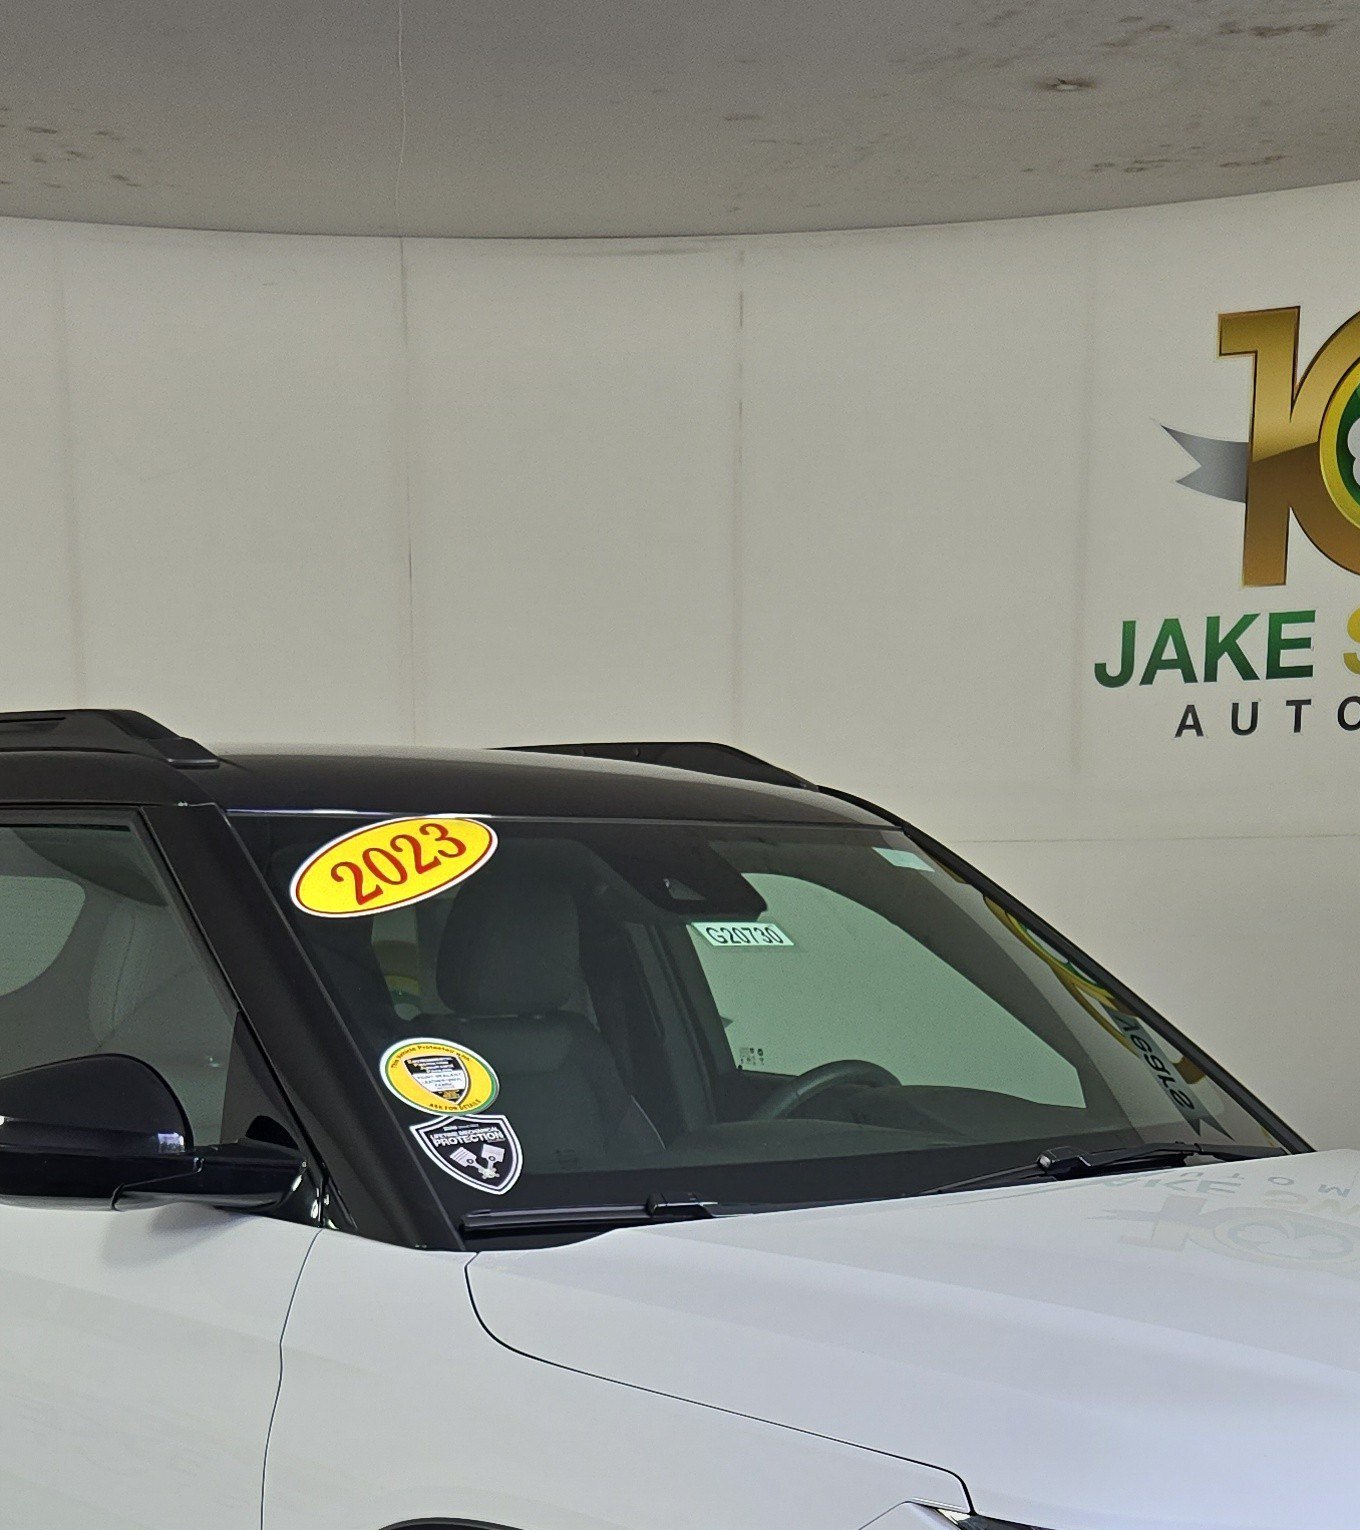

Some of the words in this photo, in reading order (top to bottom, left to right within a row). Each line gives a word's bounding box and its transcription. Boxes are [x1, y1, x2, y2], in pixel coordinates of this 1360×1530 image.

[1093, 609, 1316, 689] JAKE
[330, 822, 467, 906] 2023
[706, 926, 784, 944] G20730
[434, 1130, 505, 1148] PROTECTION
